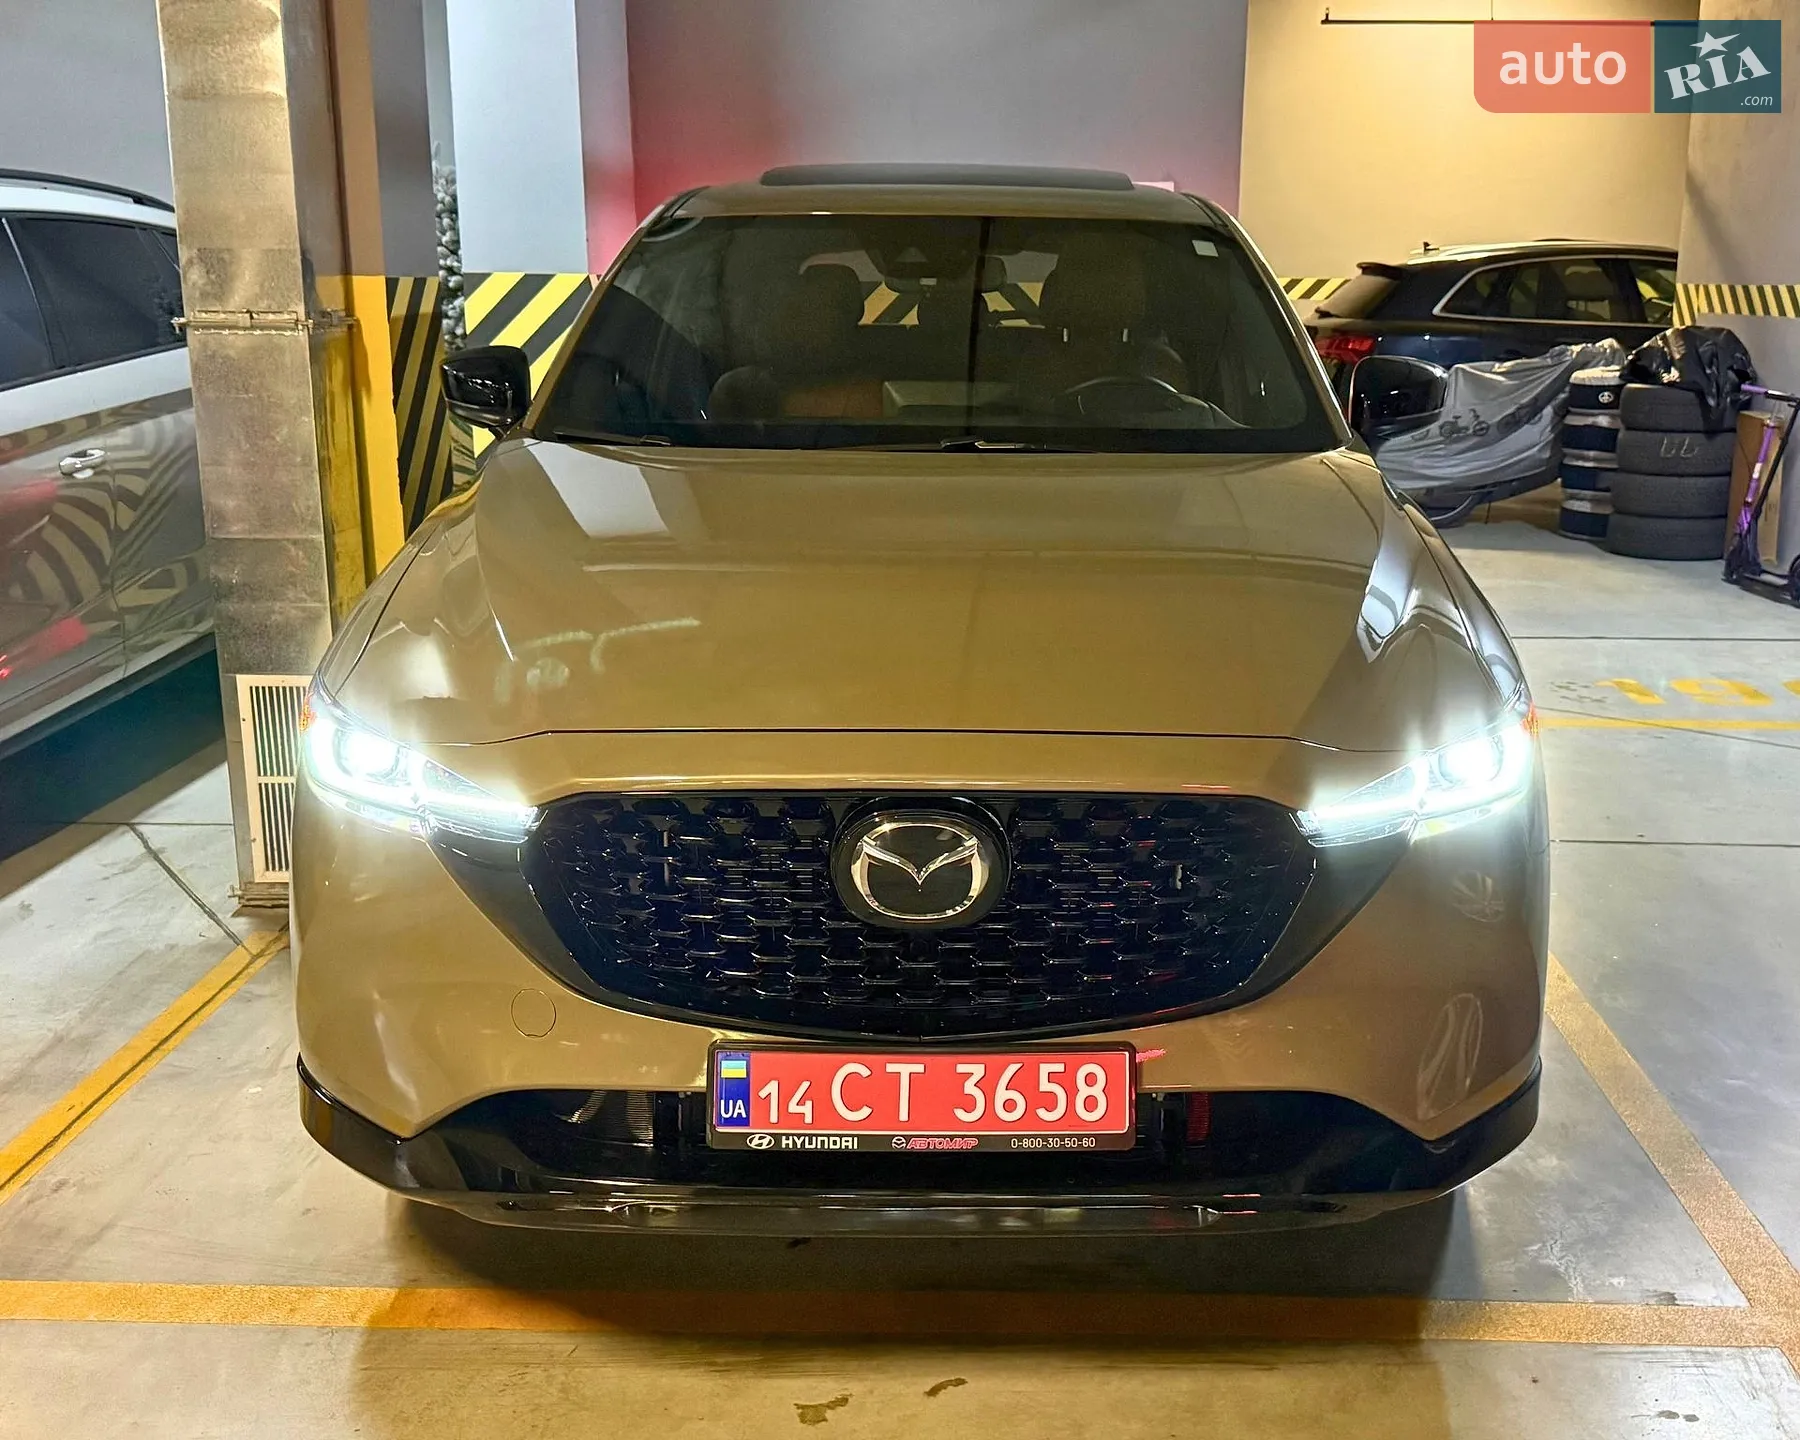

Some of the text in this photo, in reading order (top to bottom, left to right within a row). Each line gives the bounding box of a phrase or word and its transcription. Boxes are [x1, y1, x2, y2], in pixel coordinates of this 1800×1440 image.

[758, 1062, 1108, 1125] 14 CT 3658
[720, 1100, 747, 1118] UA
[781, 1136, 858, 1150] HYUNDAI
[907, 1137, 979, 1150] АВТОМИР
[1010, 1137, 1096, 1149] 0-800-30-50-60
